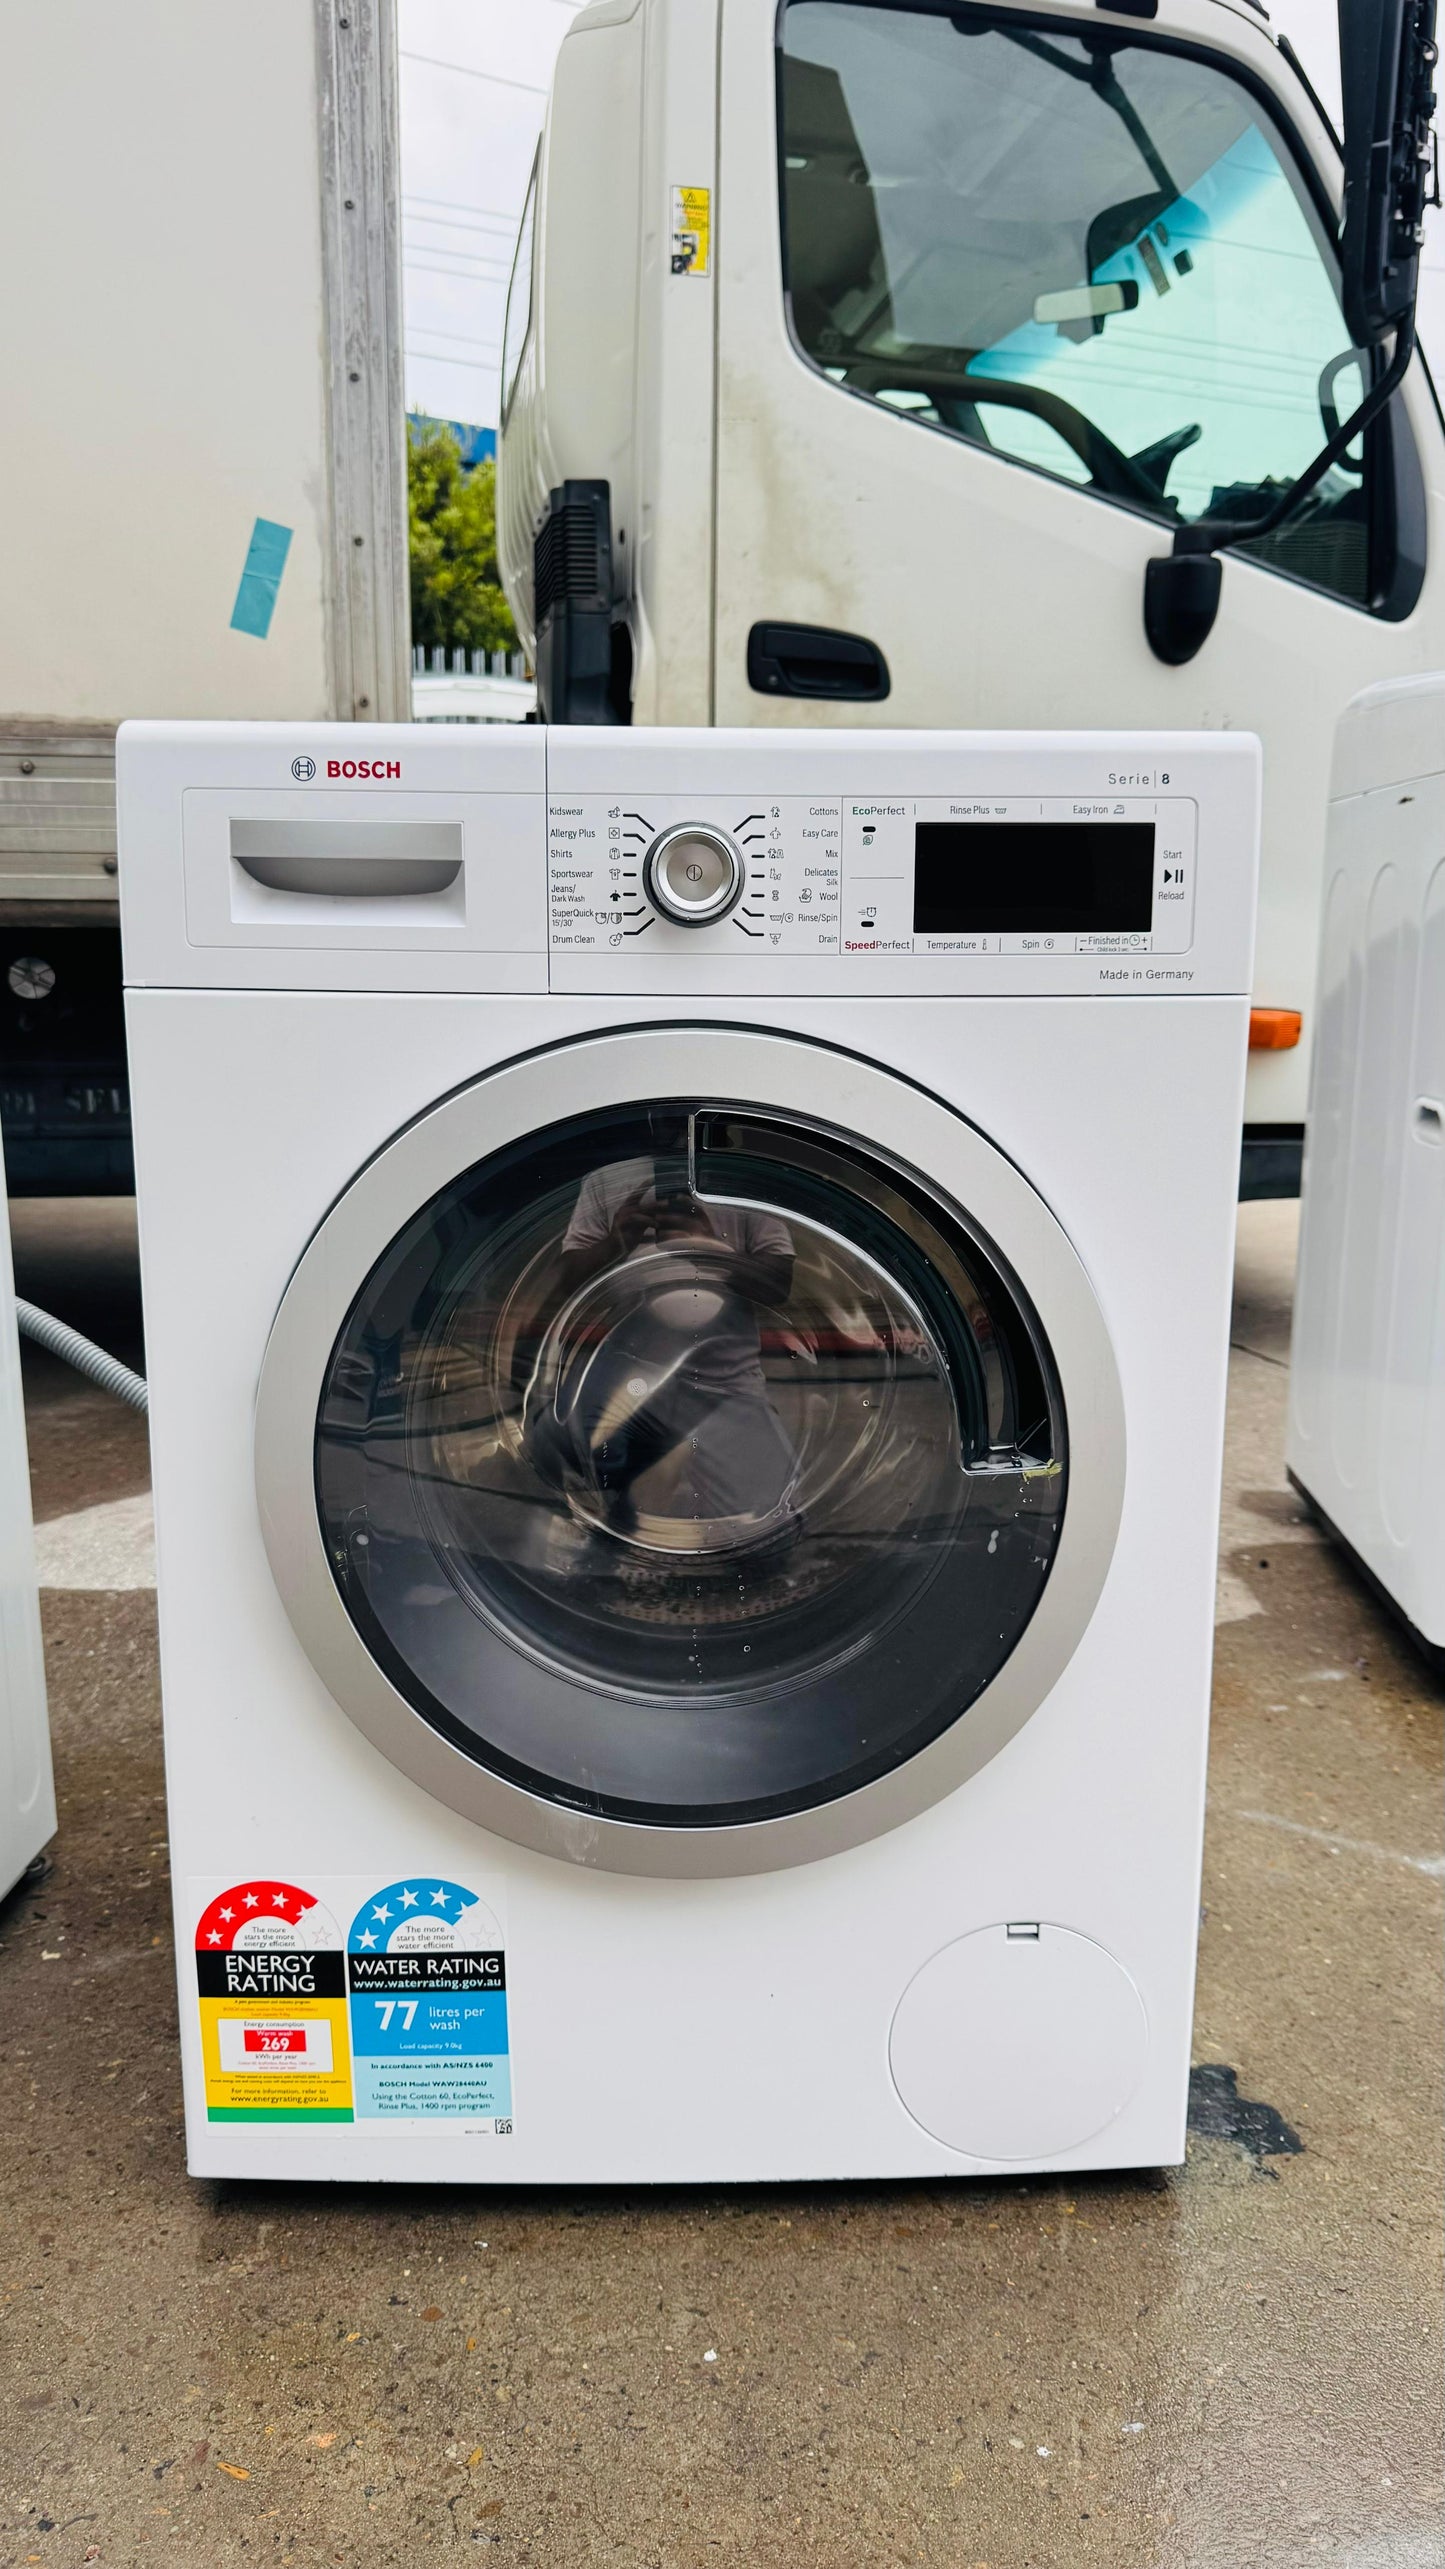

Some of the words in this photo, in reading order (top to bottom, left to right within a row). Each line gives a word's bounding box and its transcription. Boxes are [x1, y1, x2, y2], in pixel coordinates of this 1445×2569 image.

[327, 760, 400, 778] BOSCH
[1108, 773, 1149, 785] Serie
[1161, 773, 1170, 785] 8
[550, 807, 583, 815] Kidswear
[809, 807, 839, 816] Cottons
[852, 806, 905, 815] EcoPerfect
[950, 805, 971, 814] Rinse
[973, 805, 990, 814] Plus
[1073, 804, 1092, 815] Easy
[1093, 804, 1108, 814] Iron
[550, 829, 577, 839] Allergy
[579, 829, 595, 838] Plus
[802, 829, 819, 839] Easy
[821, 829, 838, 837] Care
[550, 849, 573, 858] Shirts
[825, 849, 838, 858] Mix
[1163, 850, 1183, 859] Start
[551, 870, 593, 879] Sportswear
[804, 867, 838, 876] Delicates
[551, 884, 576, 893] Jeans/
[819, 892, 838, 901] Wool
[1158, 891, 1184, 900] Reload
[552, 908, 594, 917] SuperQuick
[798, 913, 838, 923] Rinse/Spin
[552, 934, 573, 943] Drum
[574, 934, 595, 943] Clean
[818, 934, 838, 943] Drain
[1088, 936, 1120, 945] Finished
[1121, 936, 1129, 945] in
[844, 940, 910, 951] SpeedPerfect
[927, 940, 977, 950] Temperature
[1022, 939, 1040, 950] Spin
[1099, 970, 1129, 980] Made
[1132, 970, 1142, 979] in
[1145, 969, 1194, 981] Germany
[405, 1925, 422, 1933] The
[423, 1941, 454, 1949] efficient
[225, 1955, 315, 1973] ENERGY
[353, 1959, 421, 1976] WATER
[427, 1957, 500, 1975] RATING
[227, 1974, 316, 1992] RATING
[353, 1977, 502, 1990] www.waterrating.gov.au
[374, 2000, 419, 2031] 77
[429, 2006, 461, 2018] litres
[463, 2008, 486, 2020] per
[429, 2018, 461, 2031] wash
[261, 2037, 290, 2051] 269
[417, 2043, 444, 2051] capacity
[371, 2093, 393, 2101] Using
[409, 2092, 438, 2100] Cotton
[400, 2102, 418, 2110] Plus,
[458, 2103, 491, 2111] program
